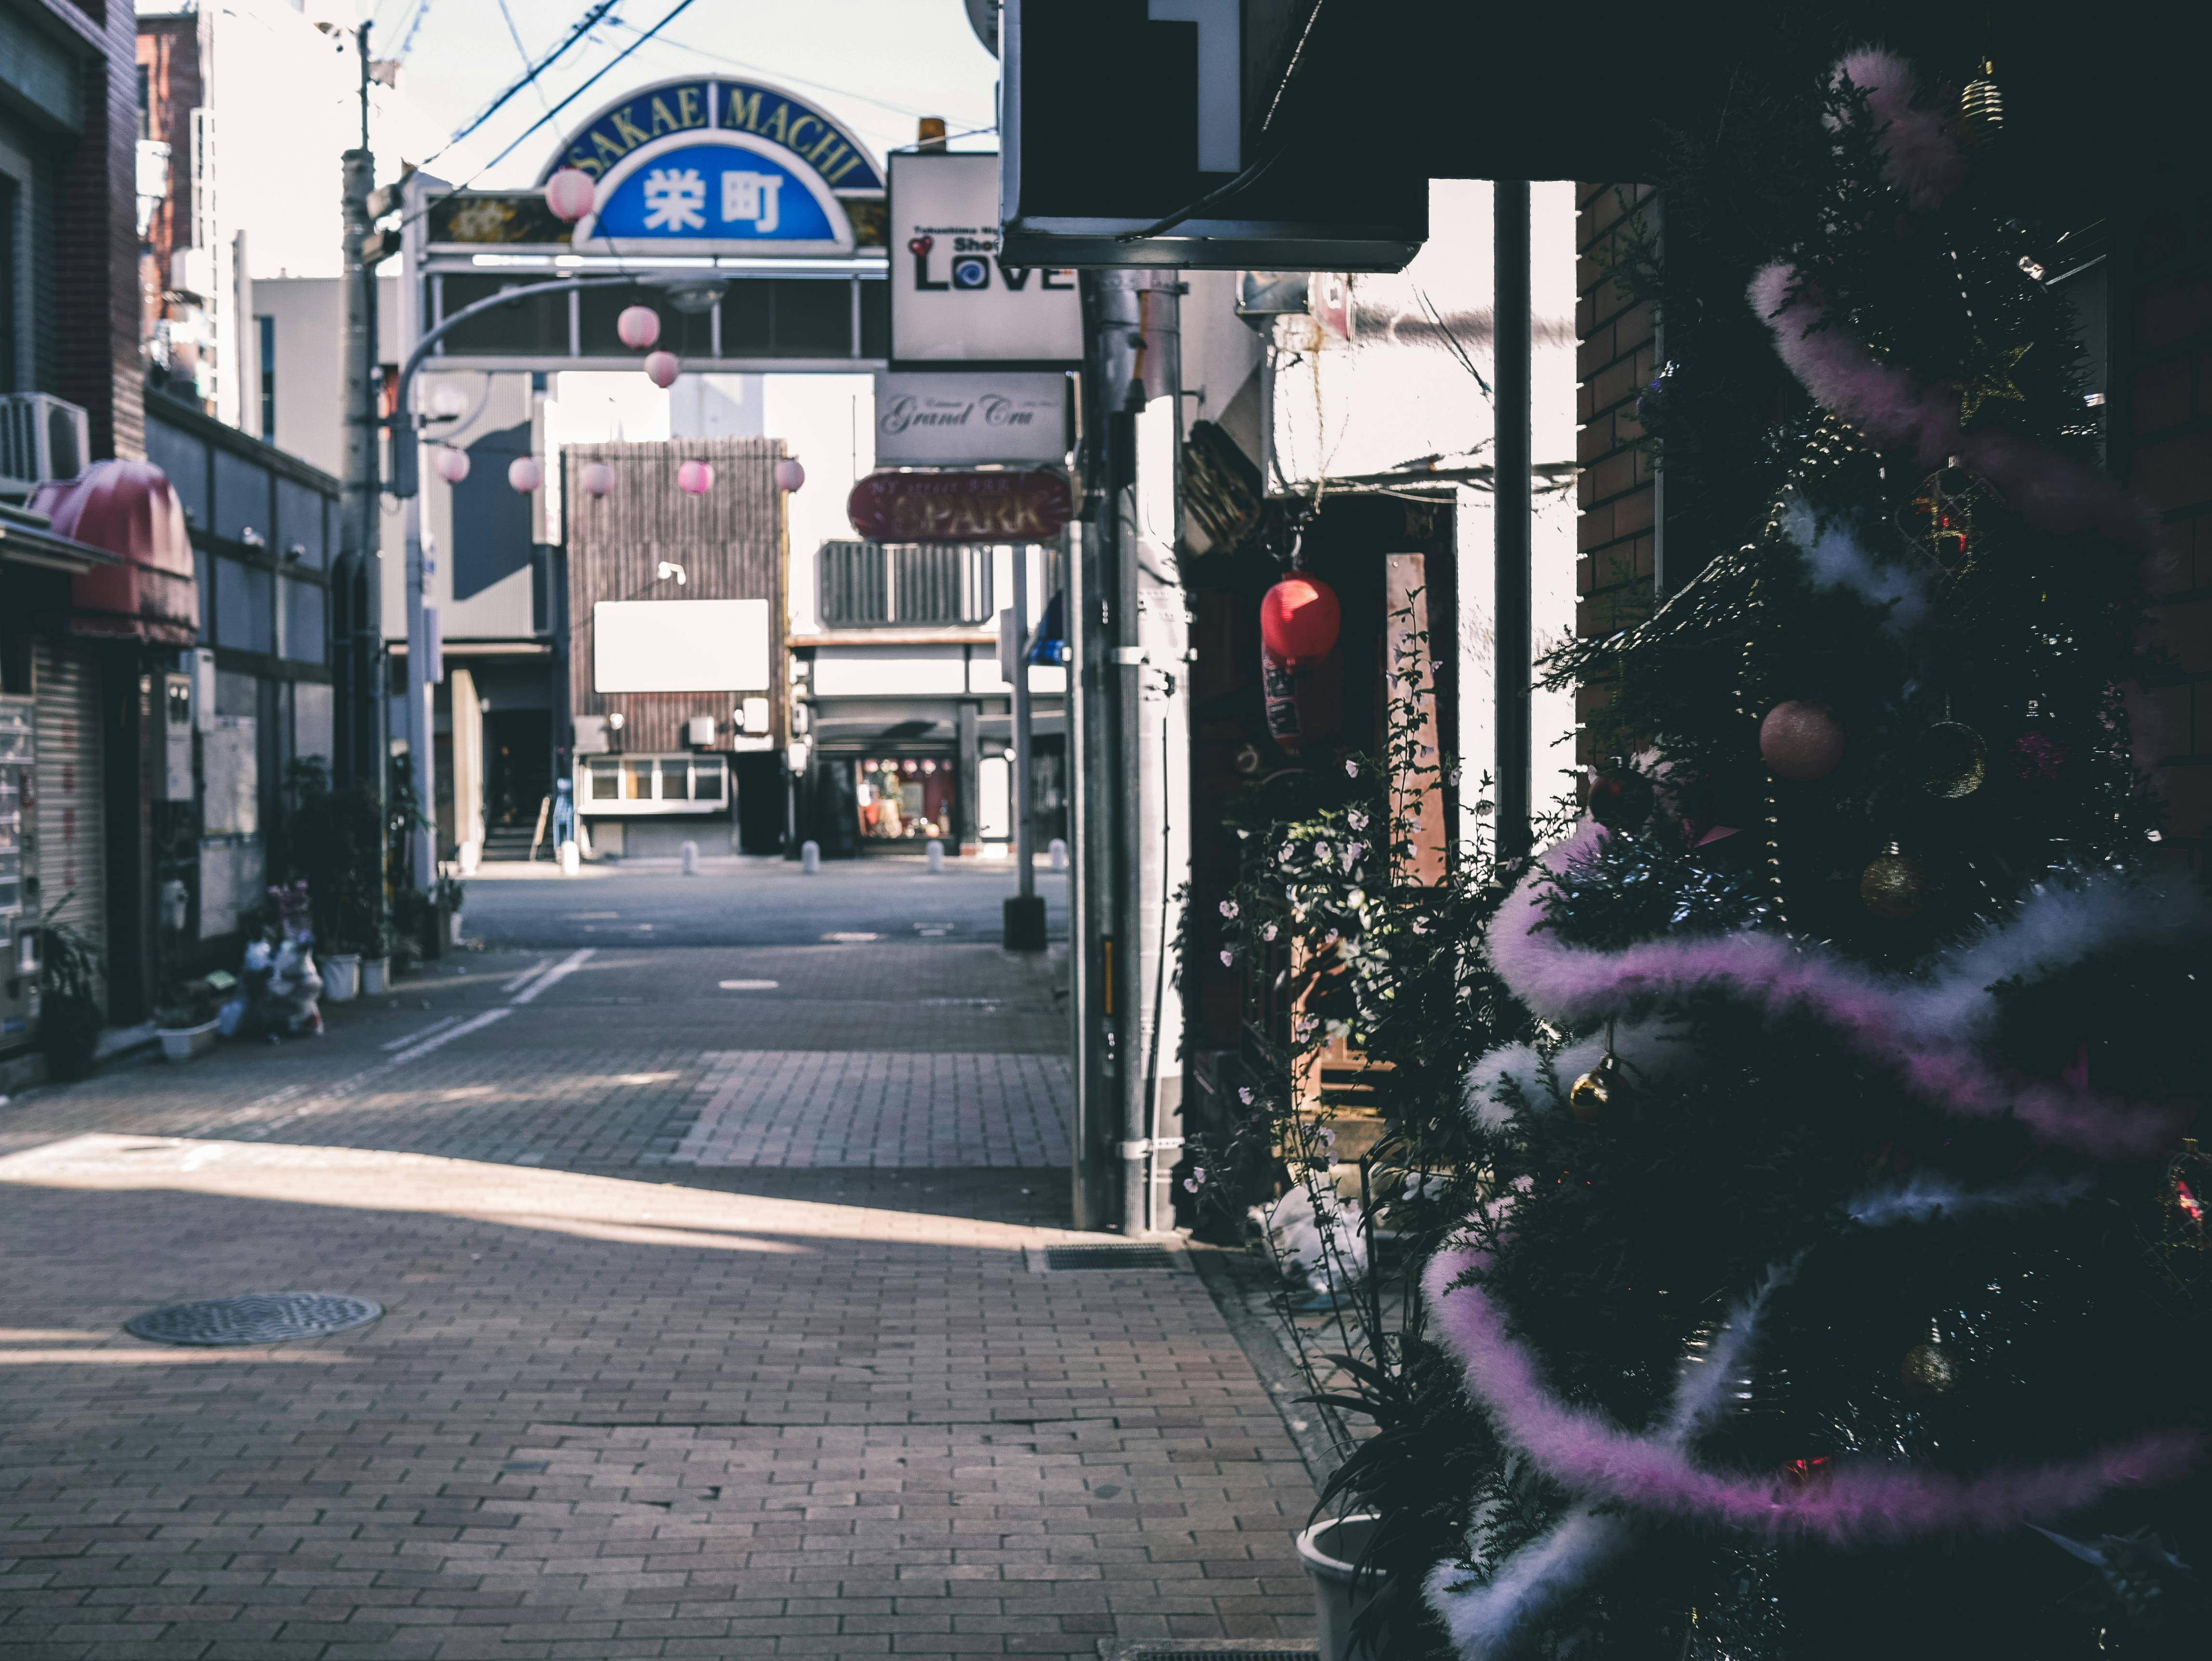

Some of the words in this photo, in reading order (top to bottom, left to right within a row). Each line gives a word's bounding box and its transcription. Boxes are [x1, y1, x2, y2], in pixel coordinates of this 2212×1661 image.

[568, 87, 707, 179] SAKAE
[726, 87, 863, 185] MACHI
[644, 168, 783, 233] 栄町
[880, 393, 974, 435] Grand
[978, 393, 1034, 426] Cru
